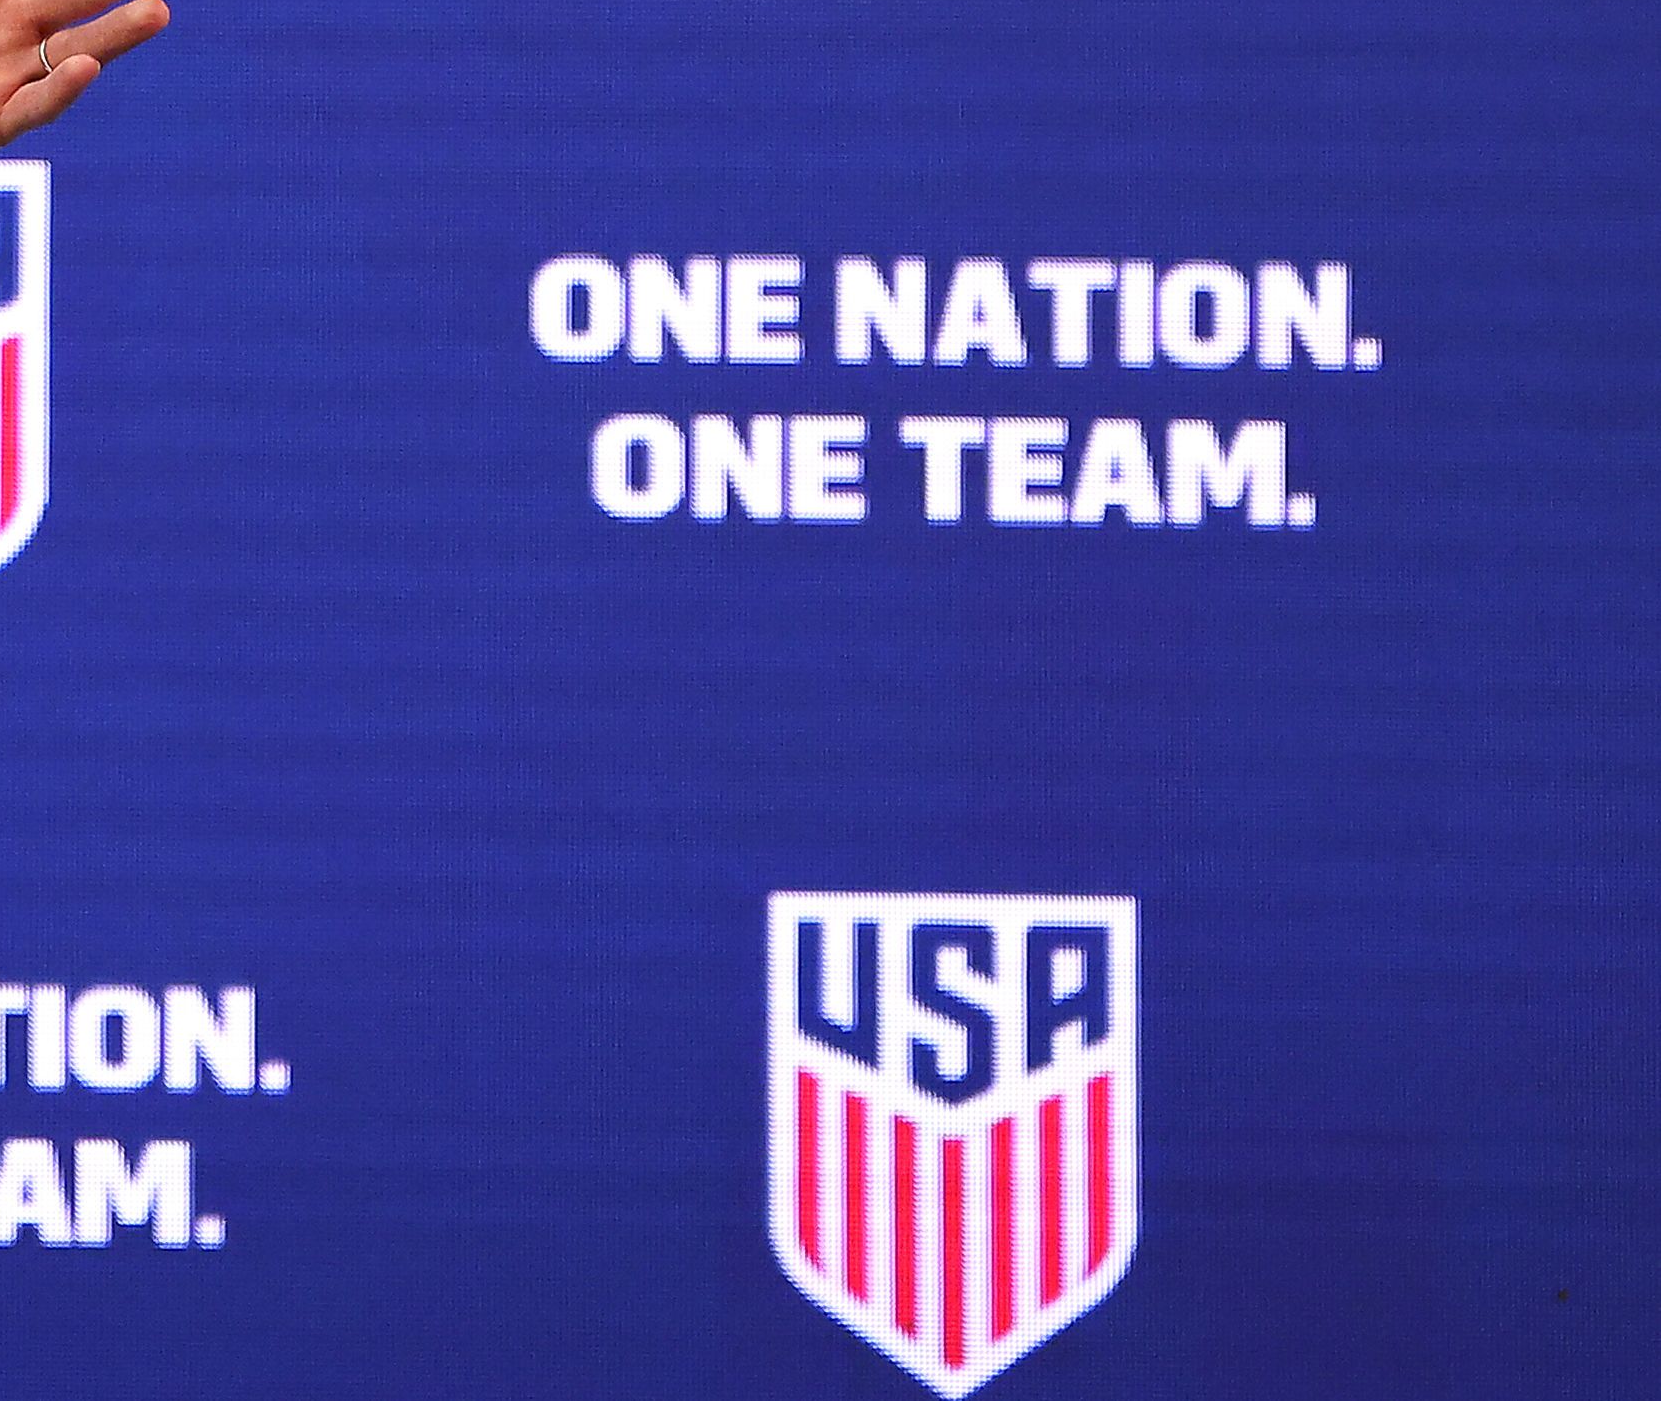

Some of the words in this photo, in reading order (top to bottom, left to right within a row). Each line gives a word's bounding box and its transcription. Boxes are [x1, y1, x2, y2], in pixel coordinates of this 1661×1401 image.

[527, 252, 807, 366] ONE
[834, 254, 1384, 372] NATION.
[590, 412, 871, 525] ONE
[897, 414, 1317, 530] TEAM.
[796, 918, 1110, 1107] USA
